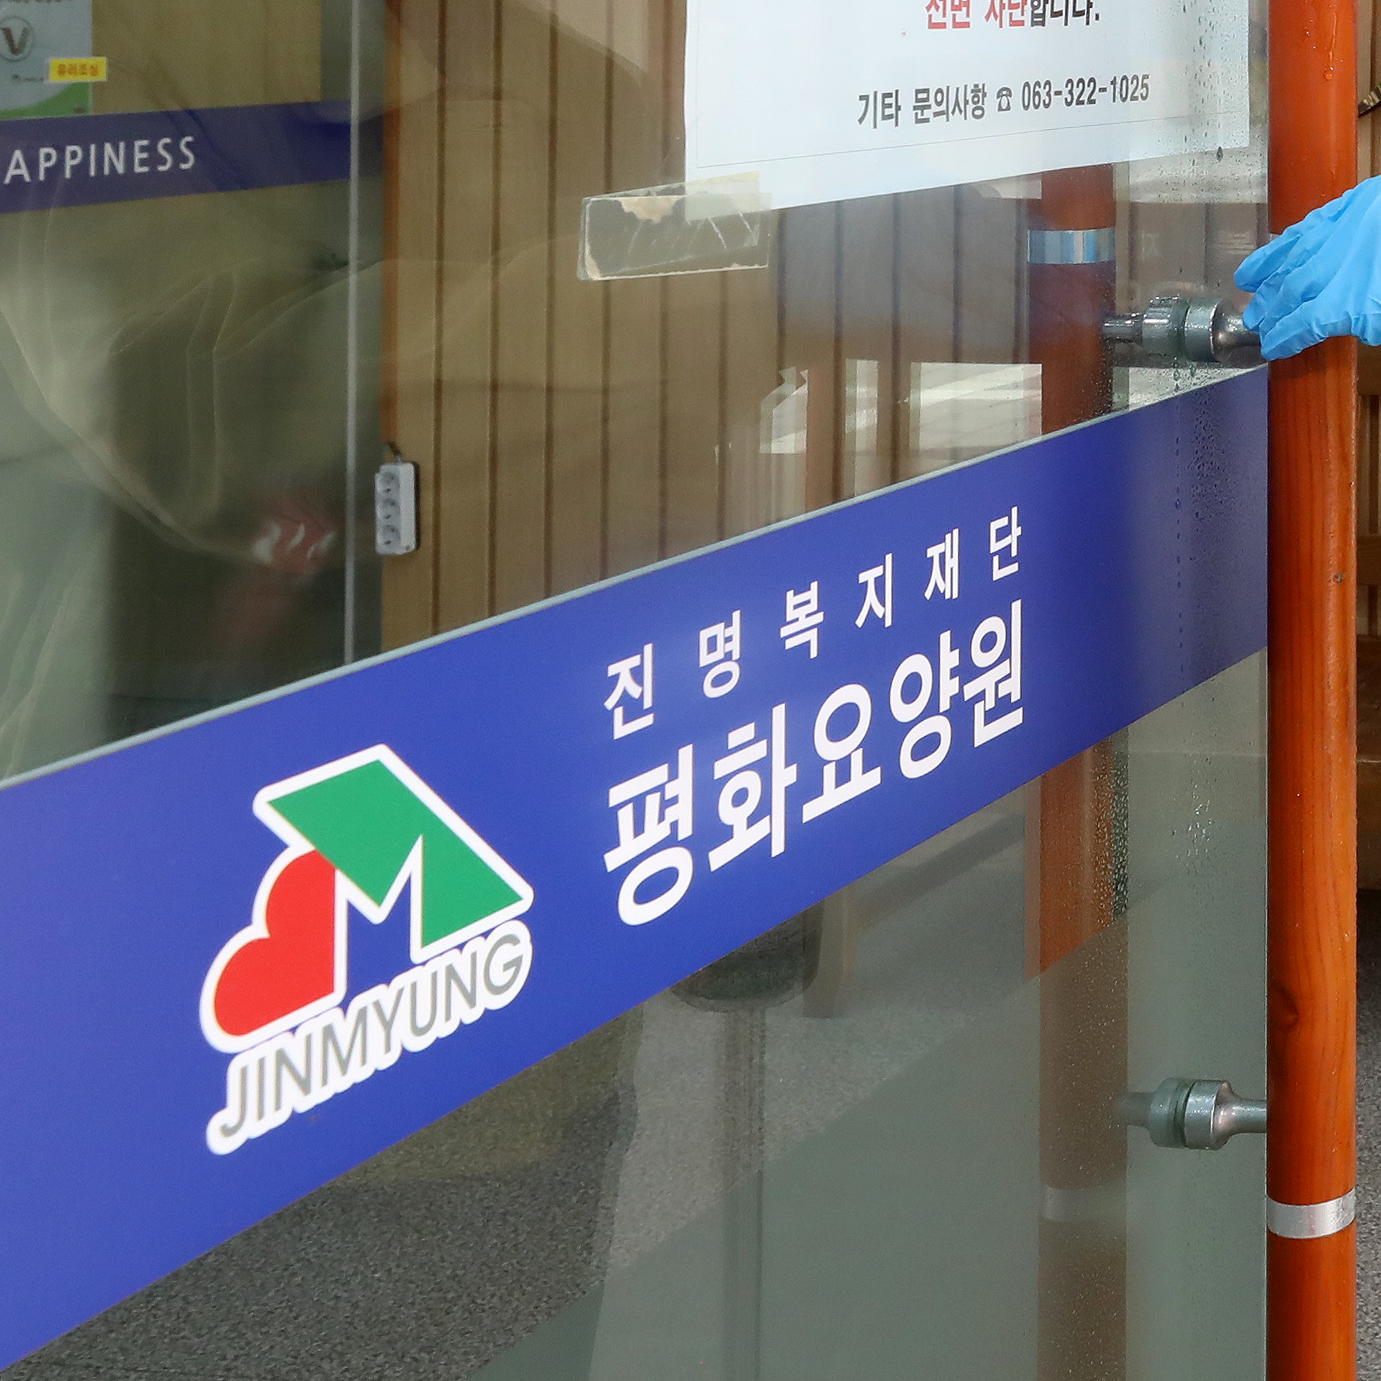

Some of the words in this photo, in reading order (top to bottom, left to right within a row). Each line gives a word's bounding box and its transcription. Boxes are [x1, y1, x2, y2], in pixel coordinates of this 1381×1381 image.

[857, 88, 902, 129] 기타
[912, 82, 987, 125] 문의사항
[1021, 73, 1151, 111] 063-322-1025
[603, 506, 1022, 740] 진명복지재단
[603, 599, 1024, 926] 평화요양원
[218, 930, 527, 1140] JINMYUNG
